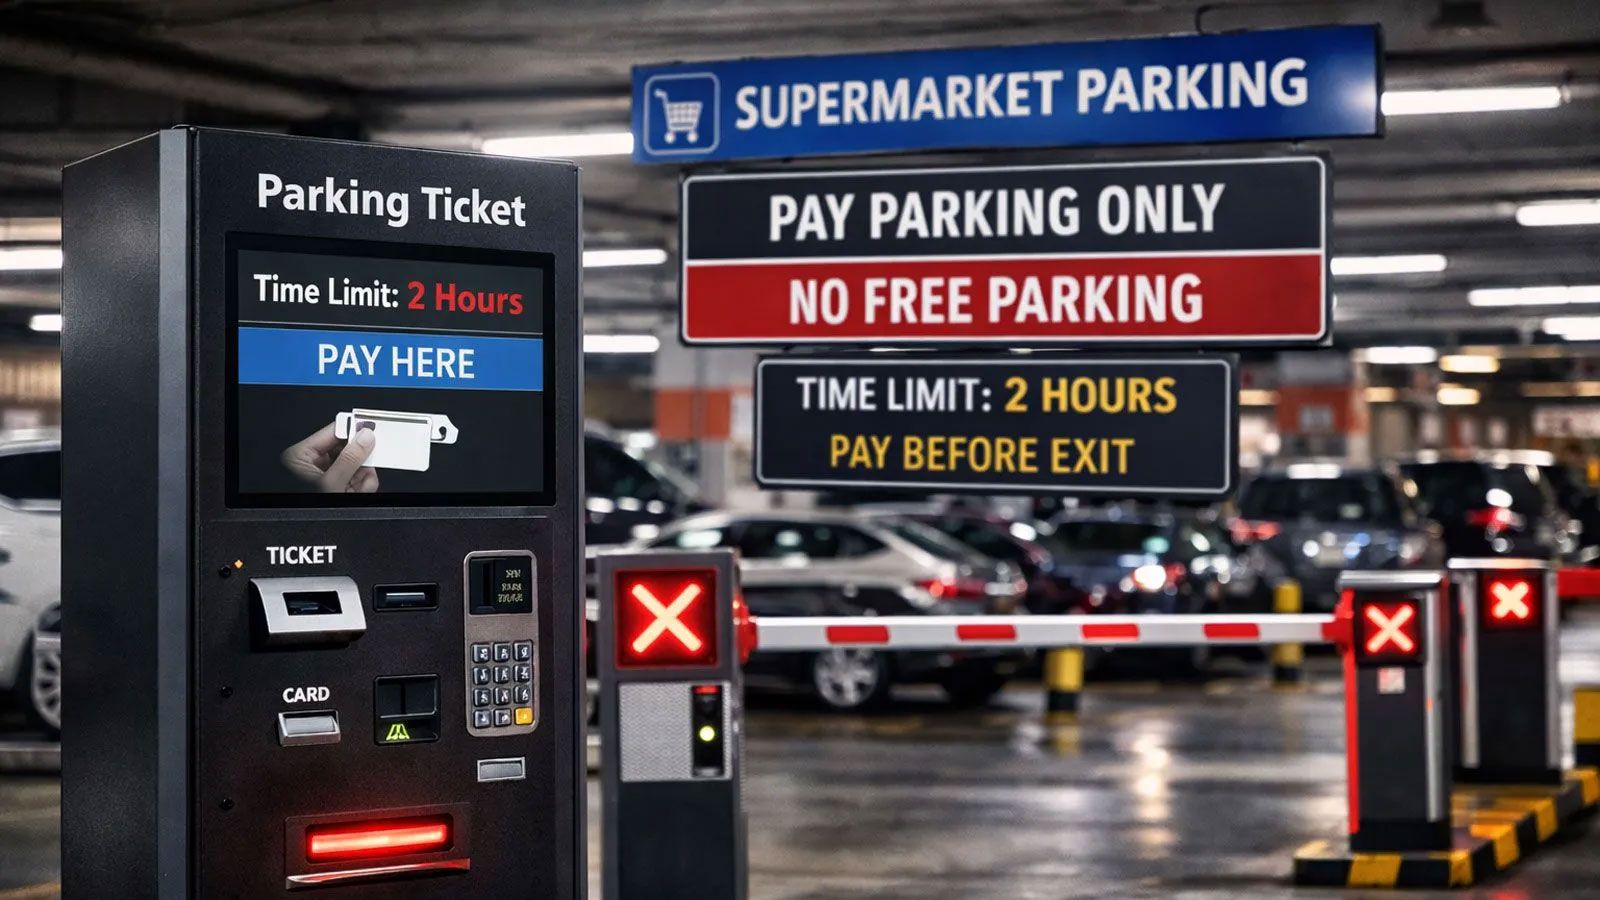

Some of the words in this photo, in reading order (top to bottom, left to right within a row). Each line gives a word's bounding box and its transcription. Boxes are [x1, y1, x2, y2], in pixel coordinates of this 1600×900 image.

[735, 70, 1064, 130] SUPERMARKET
[1077, 58, 1308, 114] PARKING
[257, 172, 410, 228] Parking
[421, 186, 527, 228] Ticket
[769, 193, 855, 242] PAY
[870, 186, 1080, 240] PARKING
[1097, 183, 1226, 236] ONLY
[253, 273, 320, 304] Time
[328, 277, 399, 308] Limit:
[407, 280, 425, 310] 2
[435, 282, 524, 315] Hours
[790, 277, 849, 325] NO
[864, 276, 973, 324] FREE
[988, 272, 1203, 323] PARKING
[318, 343, 382, 376] PAY
[392, 346, 475, 379] HERE
[796, 376, 877, 412] TIME
[887, 377, 992, 412] LIMIT:
[1005, 376, 1028, 413] 2
[1042, 376, 1177, 414] HOURS
[831, 434, 891, 469] PAY
[903, 436, 1038, 473] BEFORE
[1051, 438, 1135, 474] EXIT
[265, 545, 337, 565] TICKET
[282, 686, 331, 704] CARD
